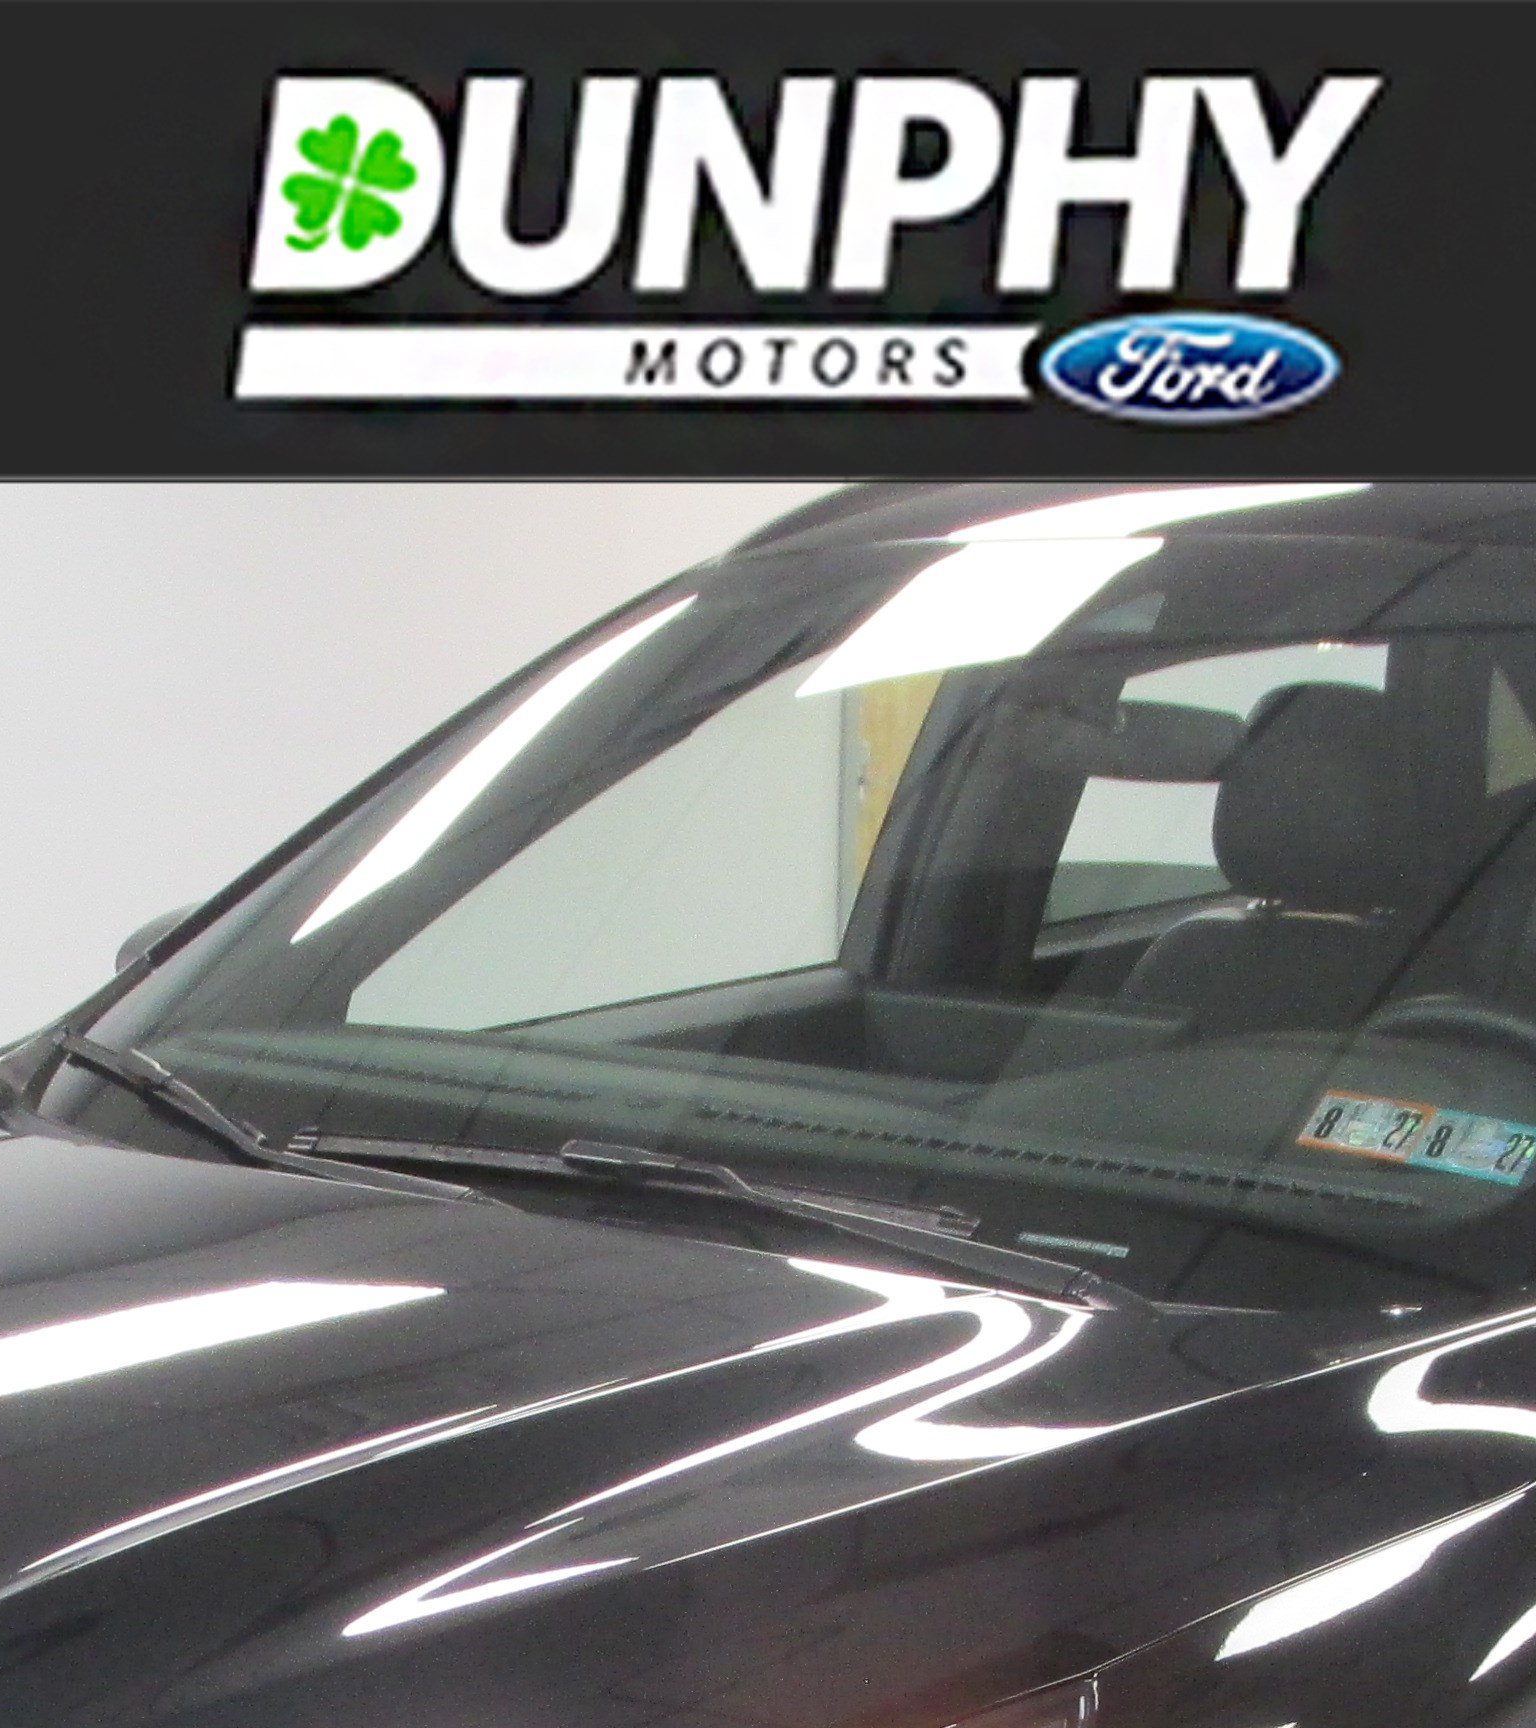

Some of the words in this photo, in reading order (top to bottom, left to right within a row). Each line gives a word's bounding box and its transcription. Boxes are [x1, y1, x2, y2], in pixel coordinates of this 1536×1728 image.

[1314, 1106, 1343, 1138] 8
[1382, 1110, 1423, 1150] 27
[1425, 1124, 1453, 1158] 8
[1494, 1132, 1536, 1173] 27
